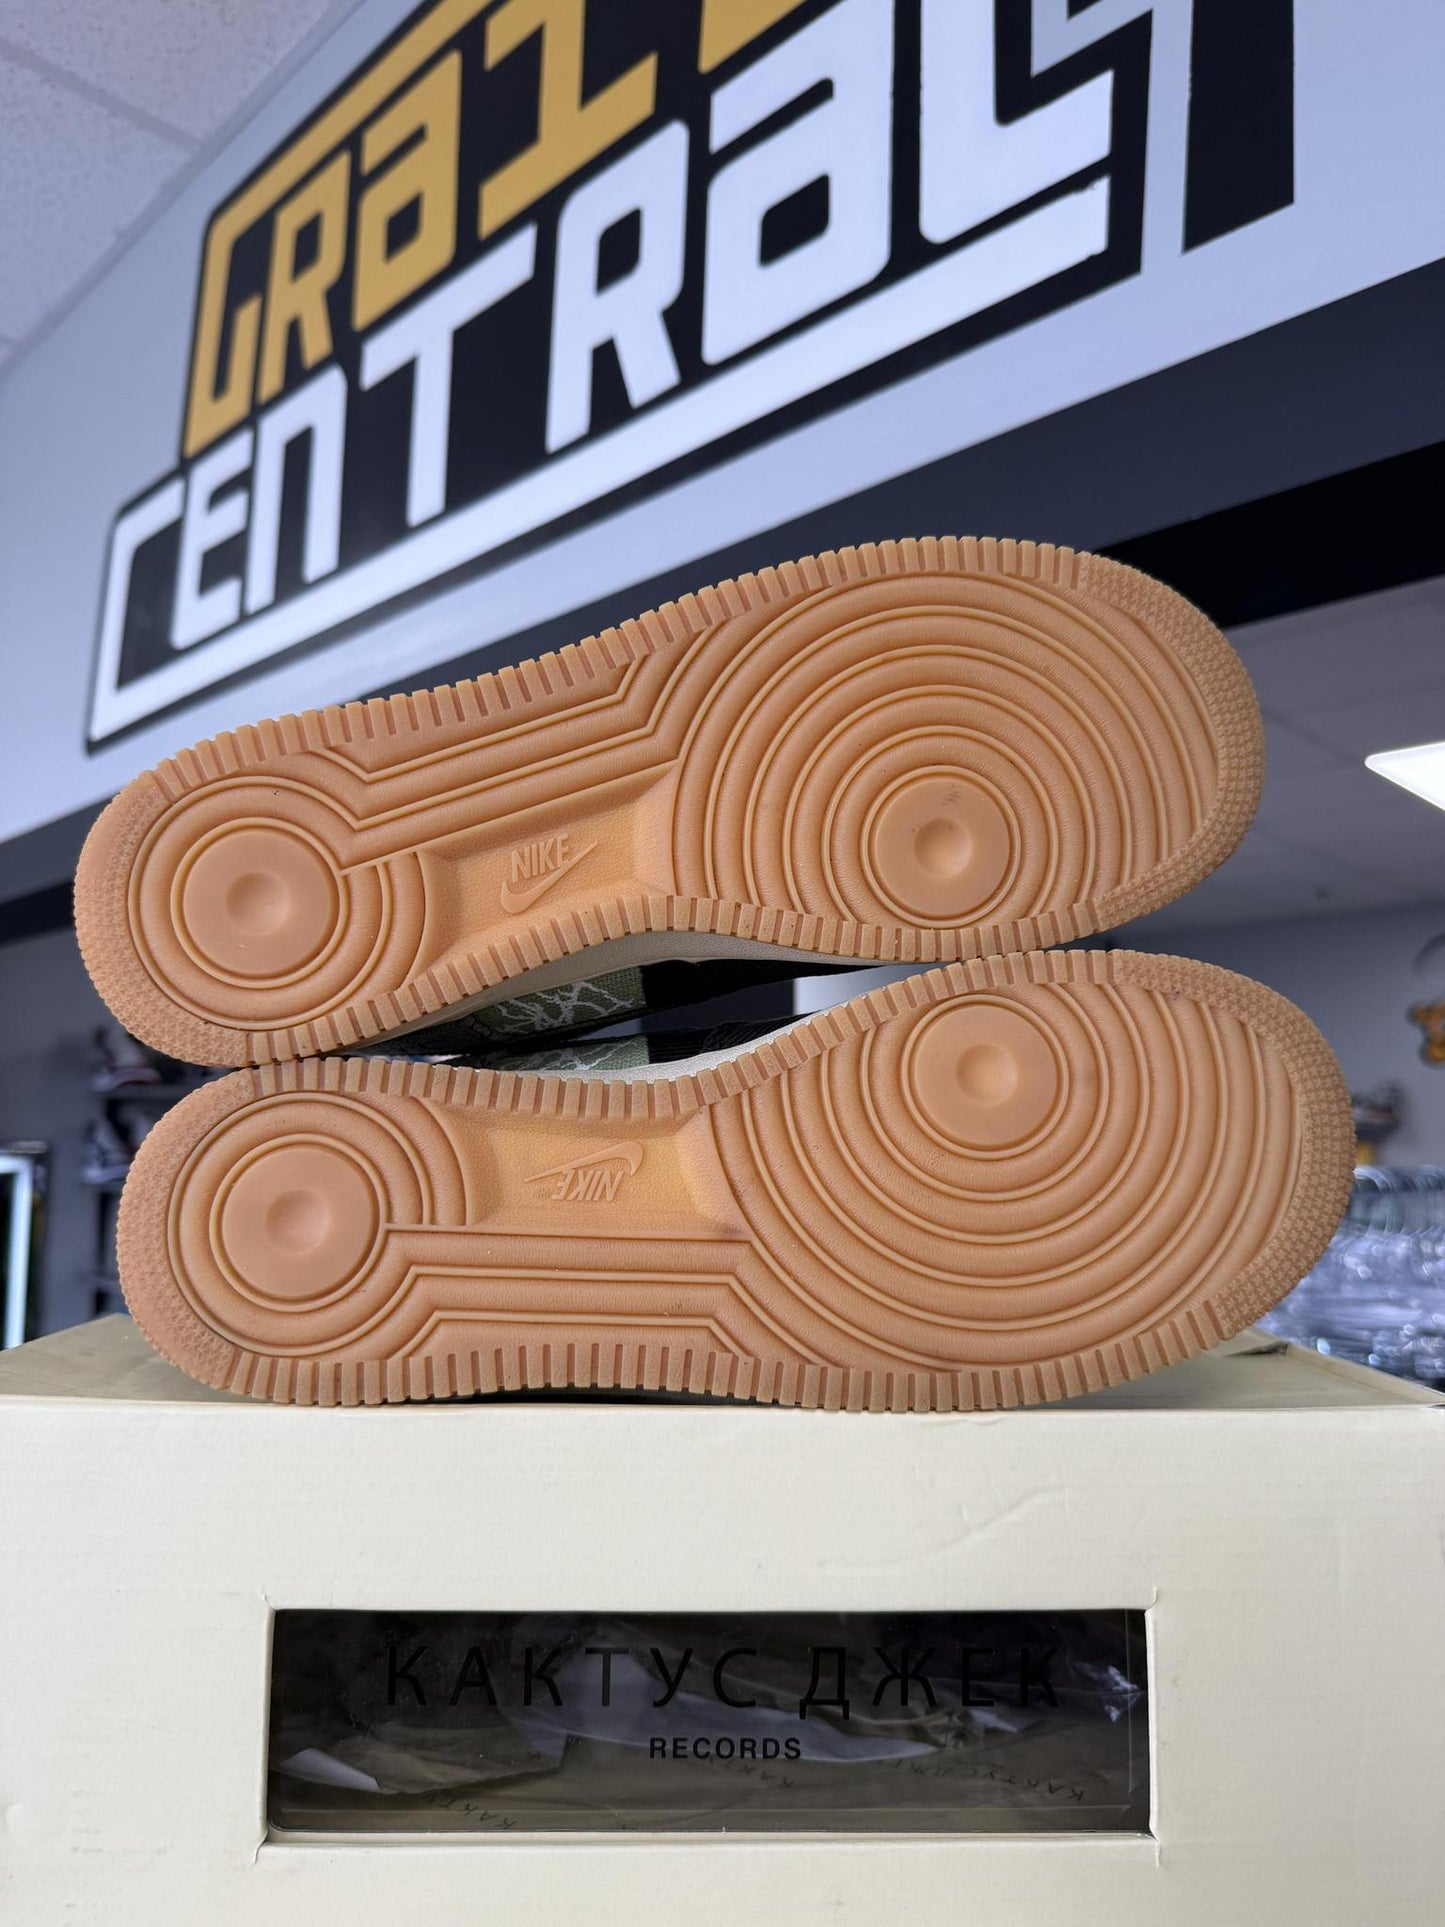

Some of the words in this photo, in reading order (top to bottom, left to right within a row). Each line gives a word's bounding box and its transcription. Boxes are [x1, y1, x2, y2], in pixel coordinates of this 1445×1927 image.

[511, 832, 573, 884] NIKE
[551, 1167, 624, 1201] NIKE
[386, 1645, 758, 1708] КАКТУС
[799, 1645, 1060, 1720] ДЖЕК
[649, 1737, 802, 1760] RECORDS
